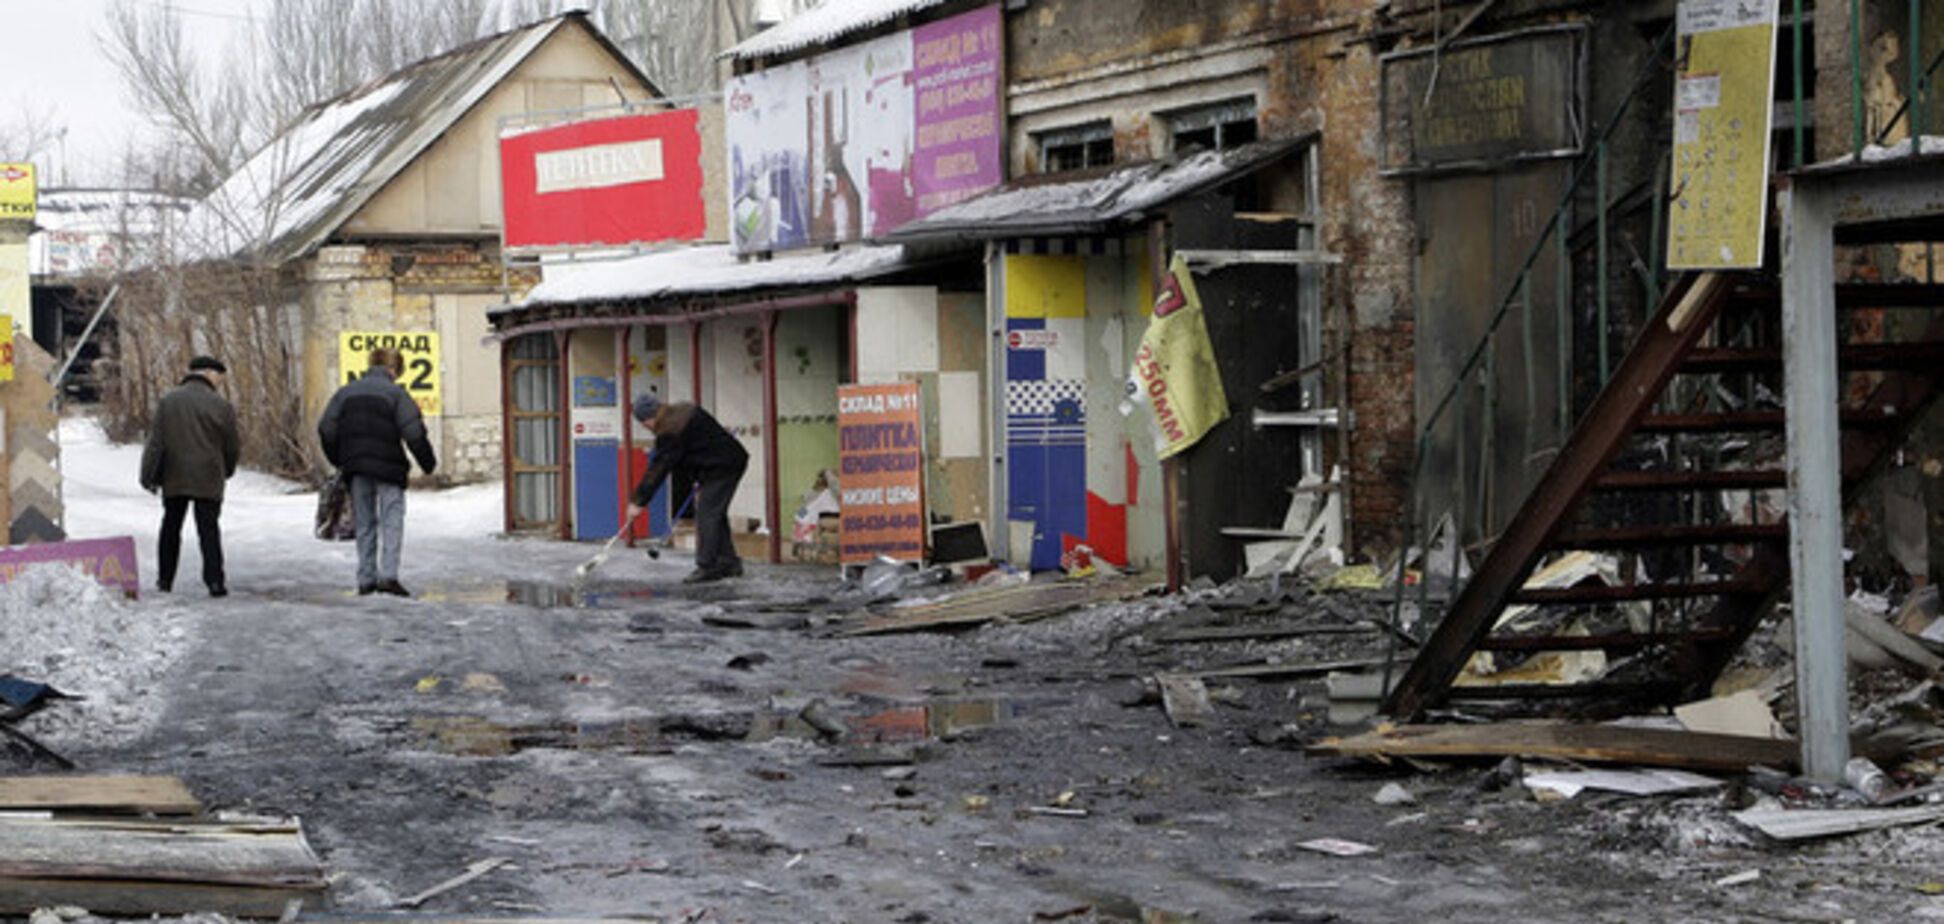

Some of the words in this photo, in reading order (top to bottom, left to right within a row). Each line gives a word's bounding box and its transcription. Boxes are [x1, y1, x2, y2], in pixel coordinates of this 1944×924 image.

[349, 335, 431, 353] СКЛАД
[839, 394, 884, 414] СКЛАД
[841, 422, 916, 451] ПЛИТКА
